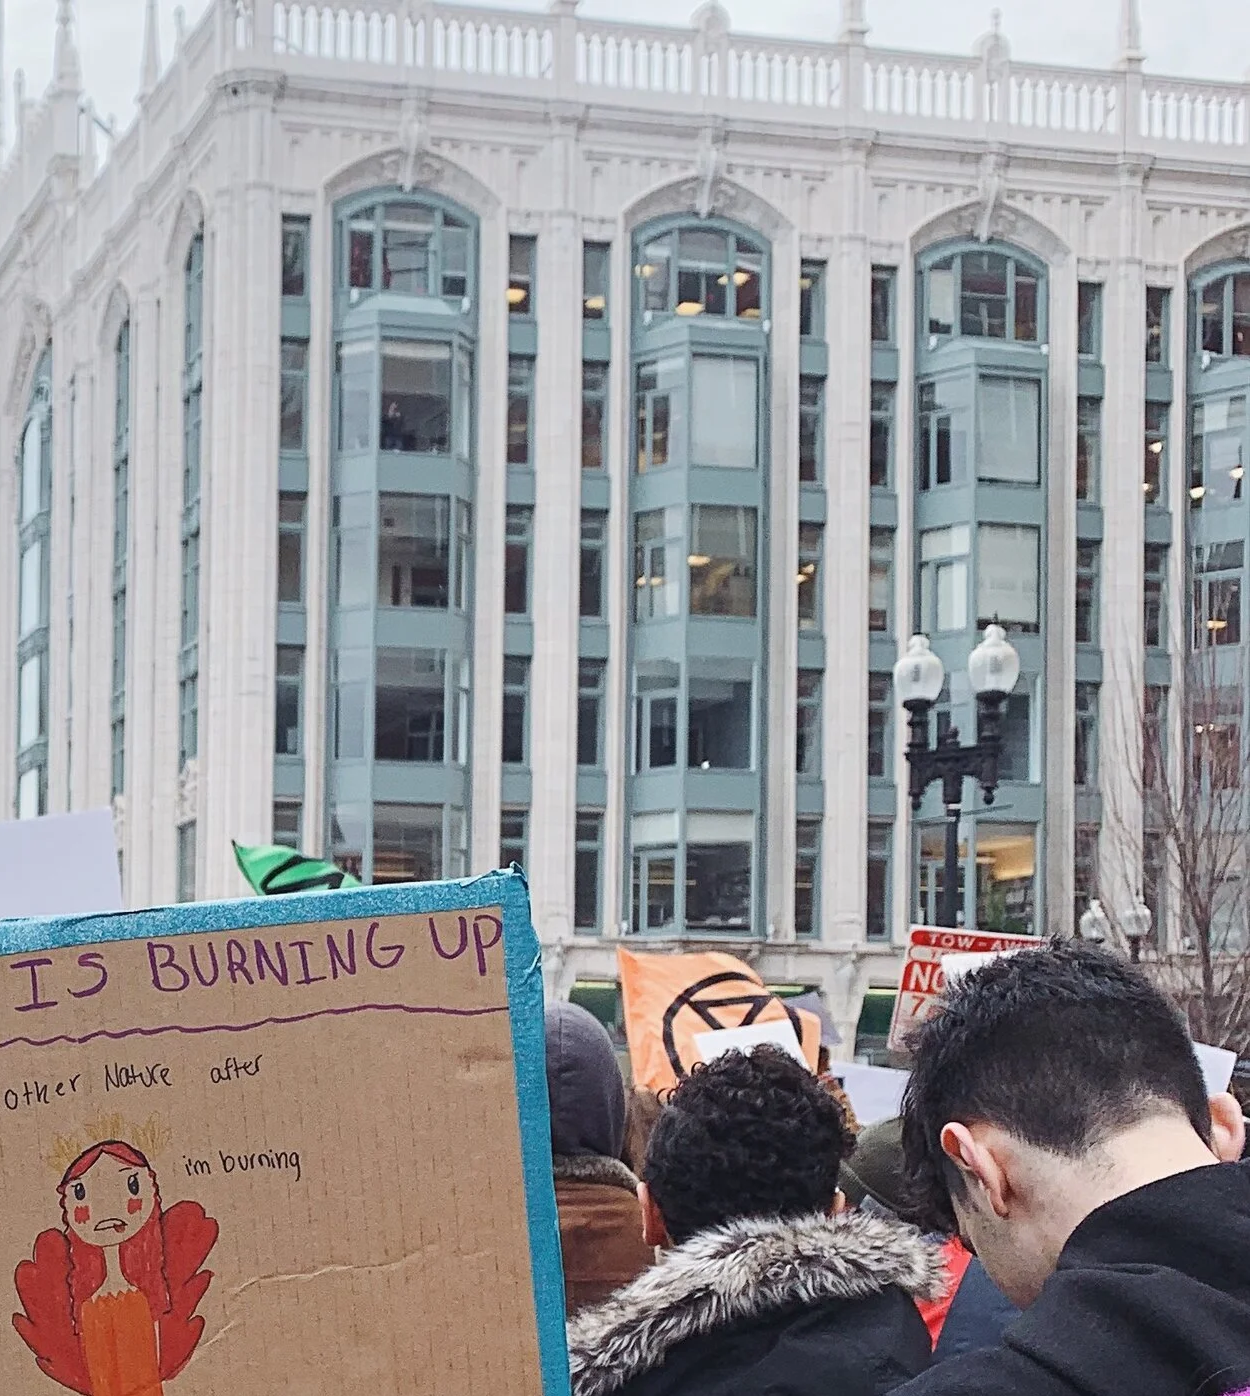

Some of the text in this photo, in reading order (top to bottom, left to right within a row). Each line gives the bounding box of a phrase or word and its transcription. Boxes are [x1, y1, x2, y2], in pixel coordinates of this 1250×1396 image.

[10, 952, 109, 1012] IS
[146, 921, 405, 993] BURNING
[429, 914, 503, 976] UP
[104, 1062, 173, 1093] Nature
[210, 1055, 263, 1085] after
[218, 1149, 302, 1183] burning
